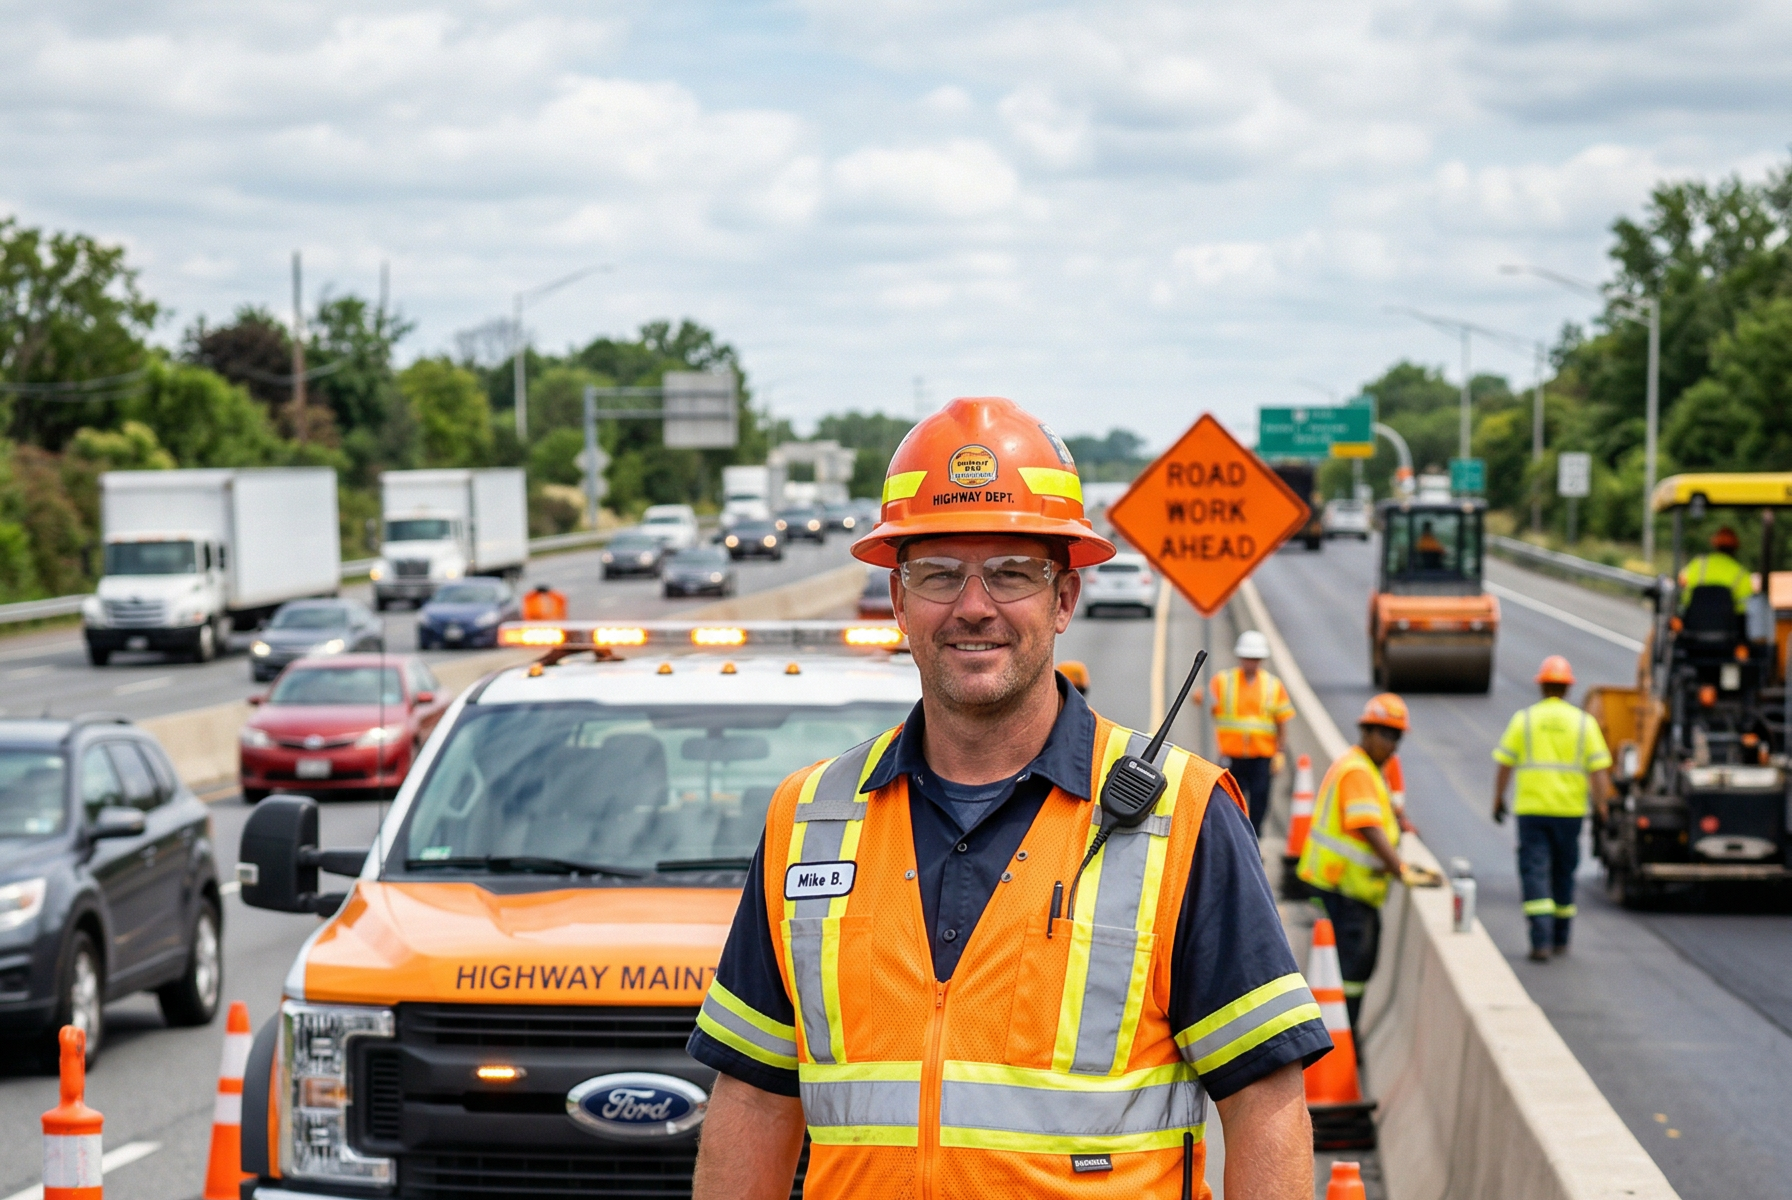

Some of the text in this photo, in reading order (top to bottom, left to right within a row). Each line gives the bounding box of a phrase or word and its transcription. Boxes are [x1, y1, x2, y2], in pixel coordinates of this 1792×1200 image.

[1166, 461, 1247, 488] ROAD
[933, 491, 1015, 506] HIGHWAY DEPT.
[1164, 498, 1247, 525] WORK
[1159, 533, 1257, 560] AHEAD
[797, 871, 843, 888] Mike B.
[456, 965, 610, 990] HIGHWAY
[601, 1088, 673, 1120] Ford
